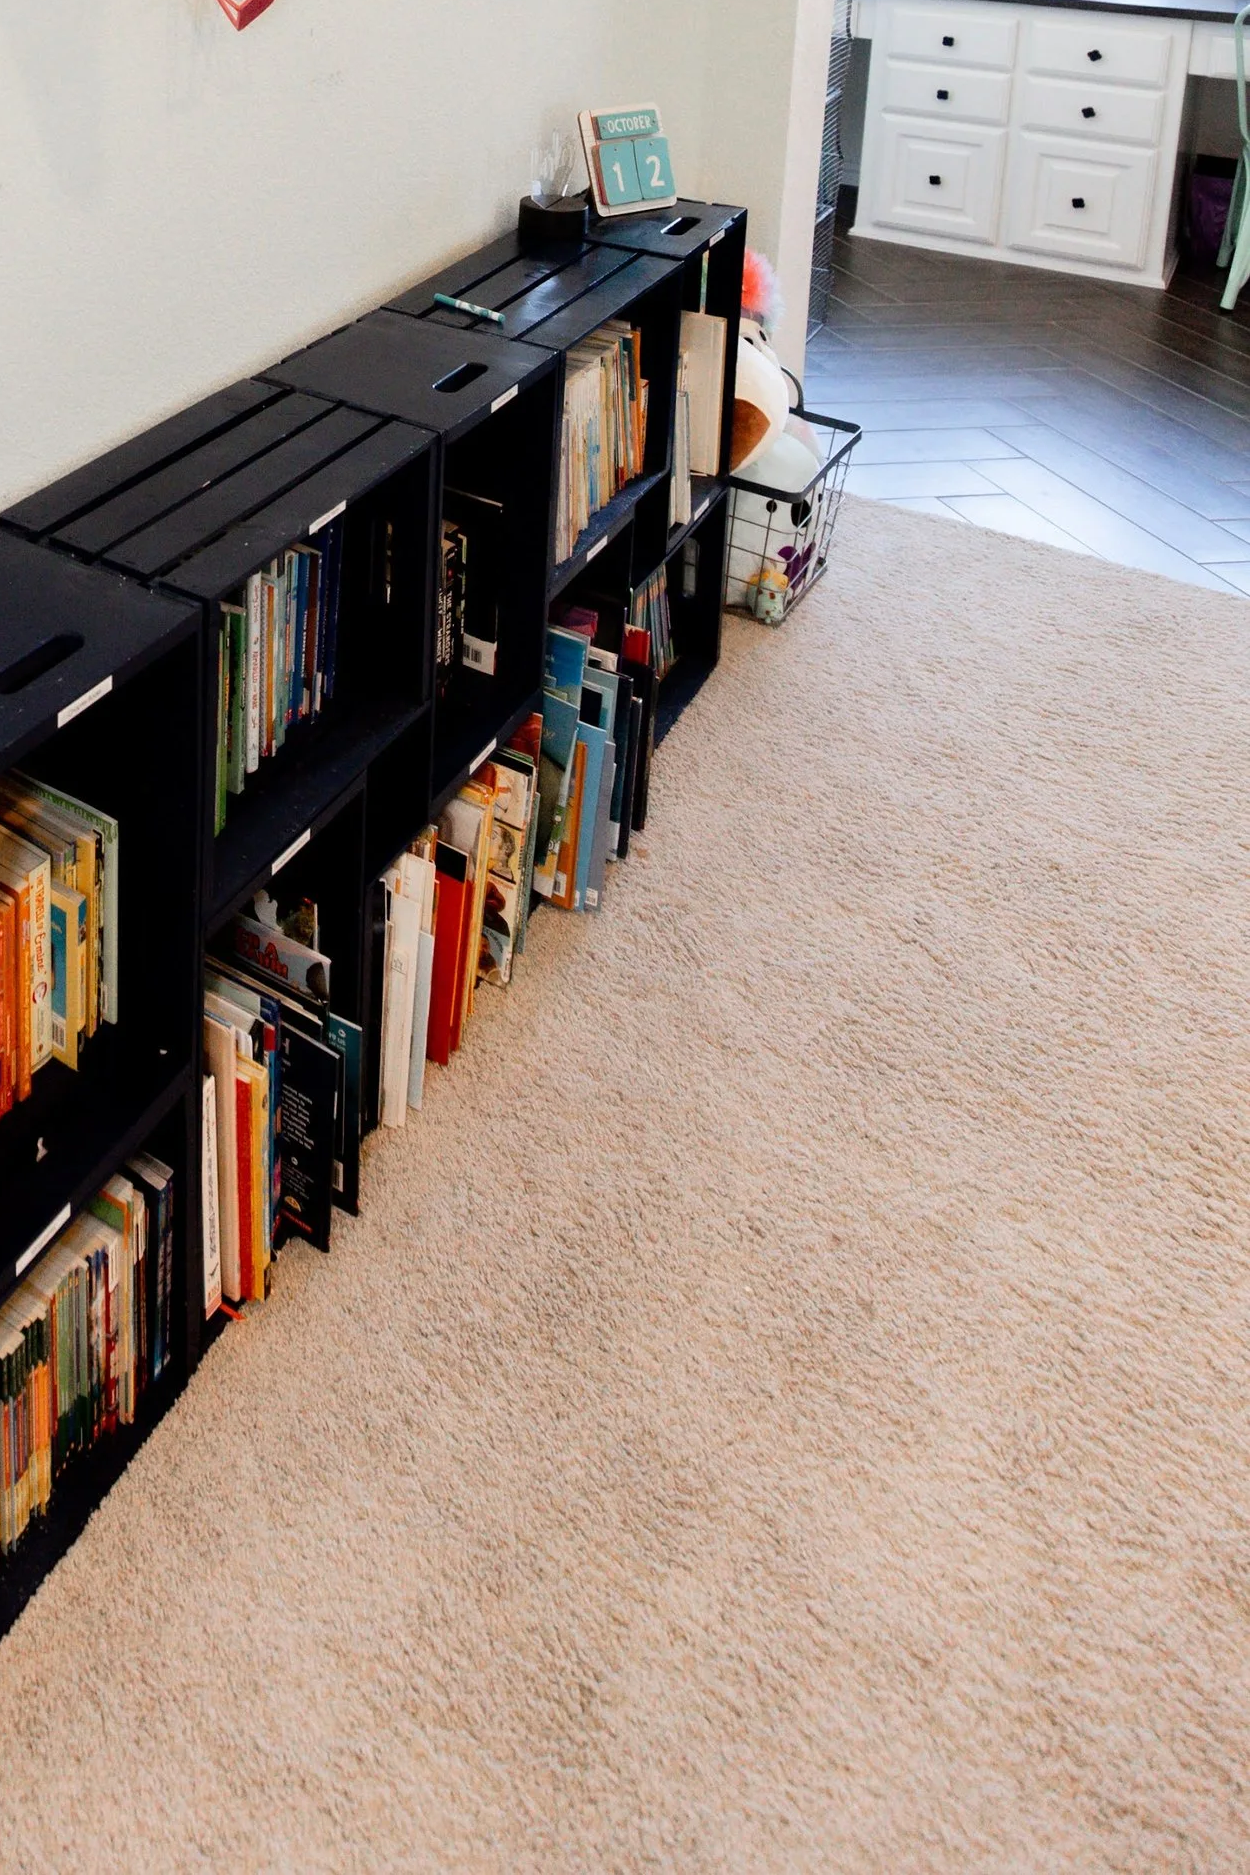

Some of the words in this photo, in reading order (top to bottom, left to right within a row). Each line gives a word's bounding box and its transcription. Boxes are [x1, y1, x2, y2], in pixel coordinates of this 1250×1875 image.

[607, 115, 651, 134] OCTOBER
[612, 161, 625, 193] 1
[645, 155, 666, 187] 2
